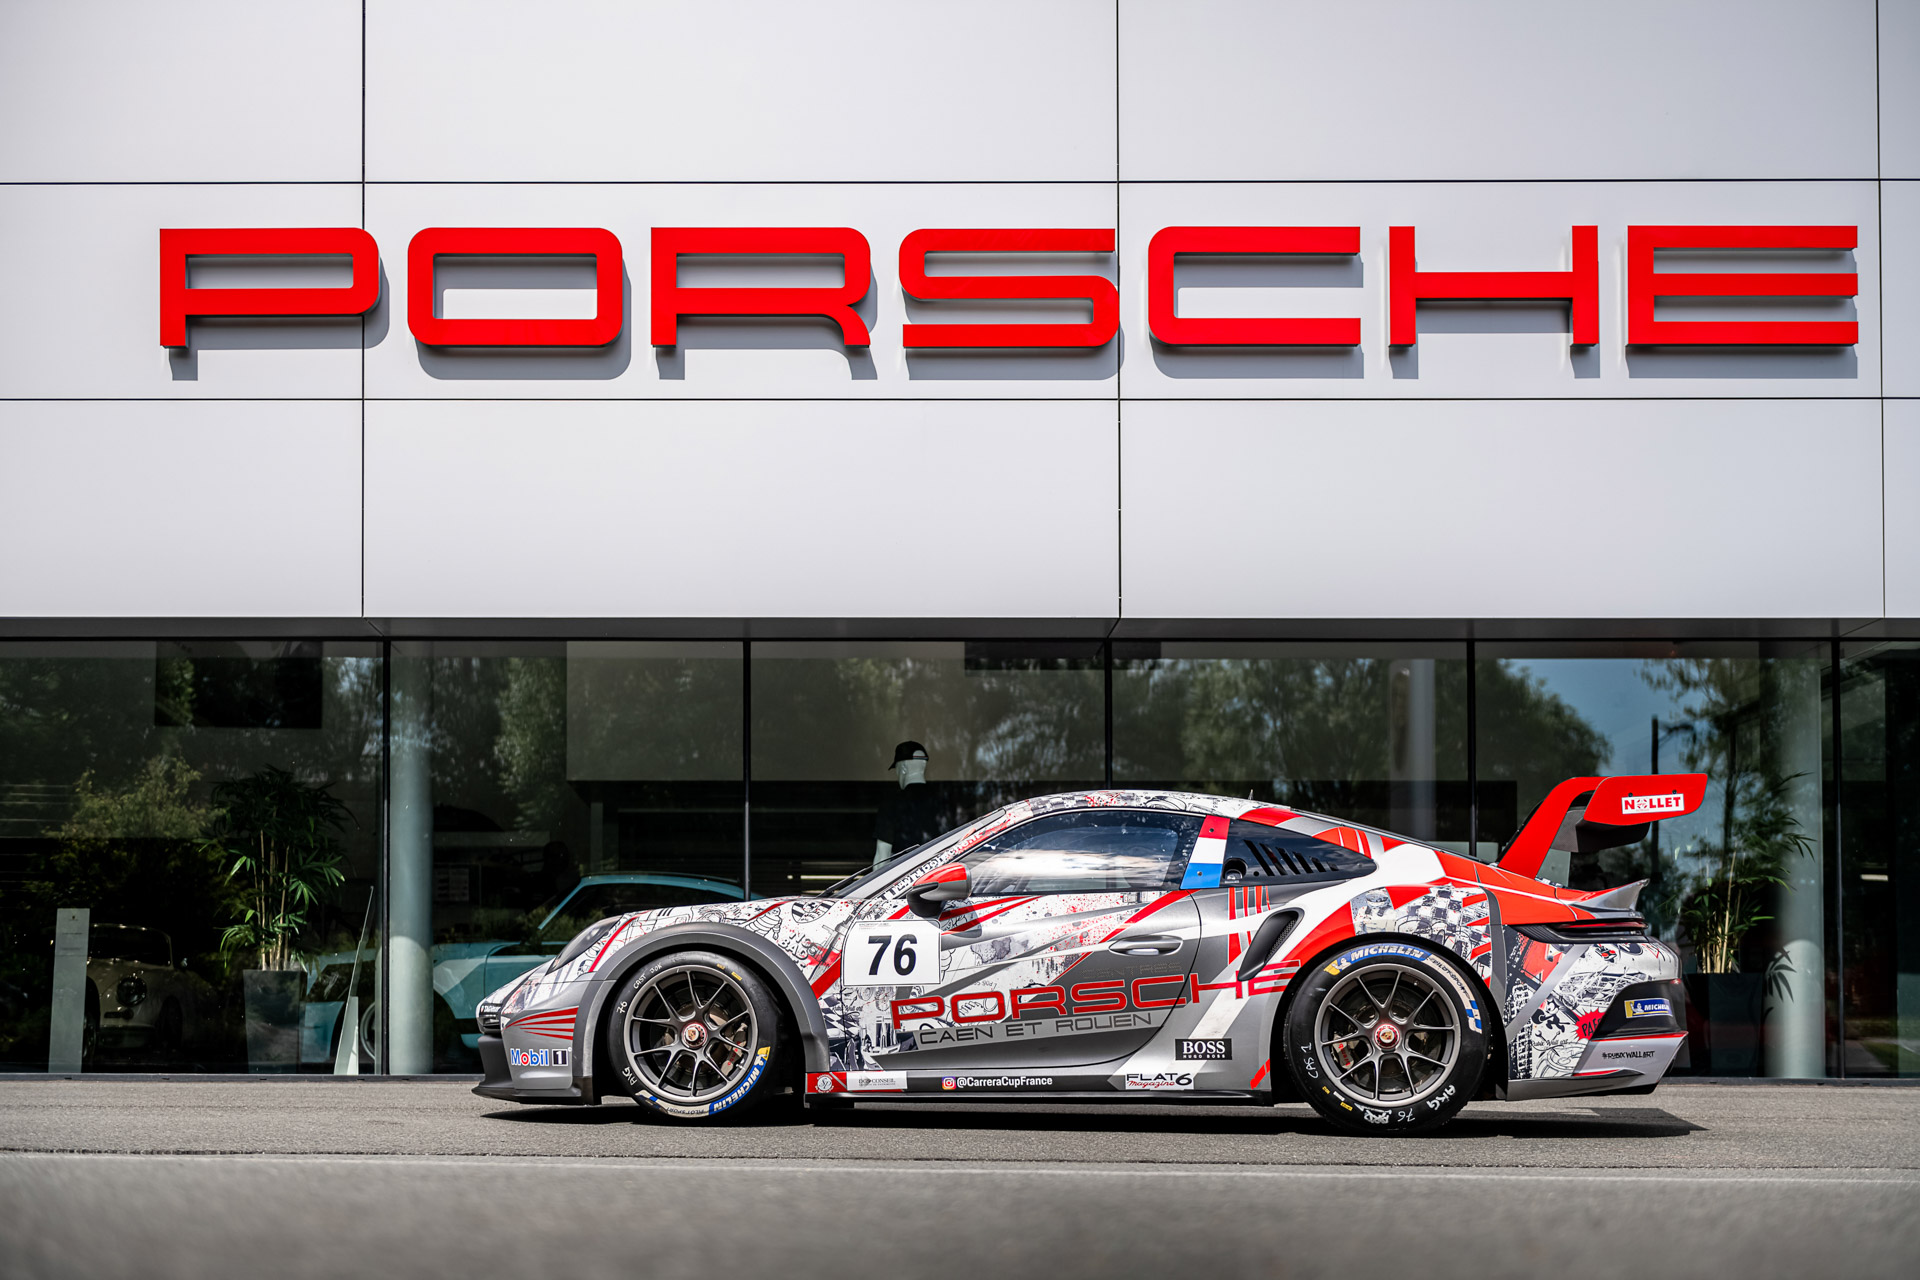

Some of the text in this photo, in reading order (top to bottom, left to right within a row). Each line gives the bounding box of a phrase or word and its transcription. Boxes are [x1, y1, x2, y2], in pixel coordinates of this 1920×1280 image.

[160, 225, 1859, 348] PORSCHE
[868, 934, 918, 976] 76
[1350, 945, 1424, 962] MICHELIN
[891, 960, 1300, 1029] PORSCHE
[616, 1001, 628, 1014] 76
[919, 1012, 1152, 1045] CAEN ET ROUEN
[1182, 1041, 1226, 1054] BOSS
[510, 1048, 549, 1067] Mobil
[956, 1076, 1053, 1088] @CarreraCupFrance
[1126, 1073, 1193, 1086] FLAT 6
[713, 1067, 761, 1112] MICHELIN
[1397, 1108, 1416, 1122] 76
